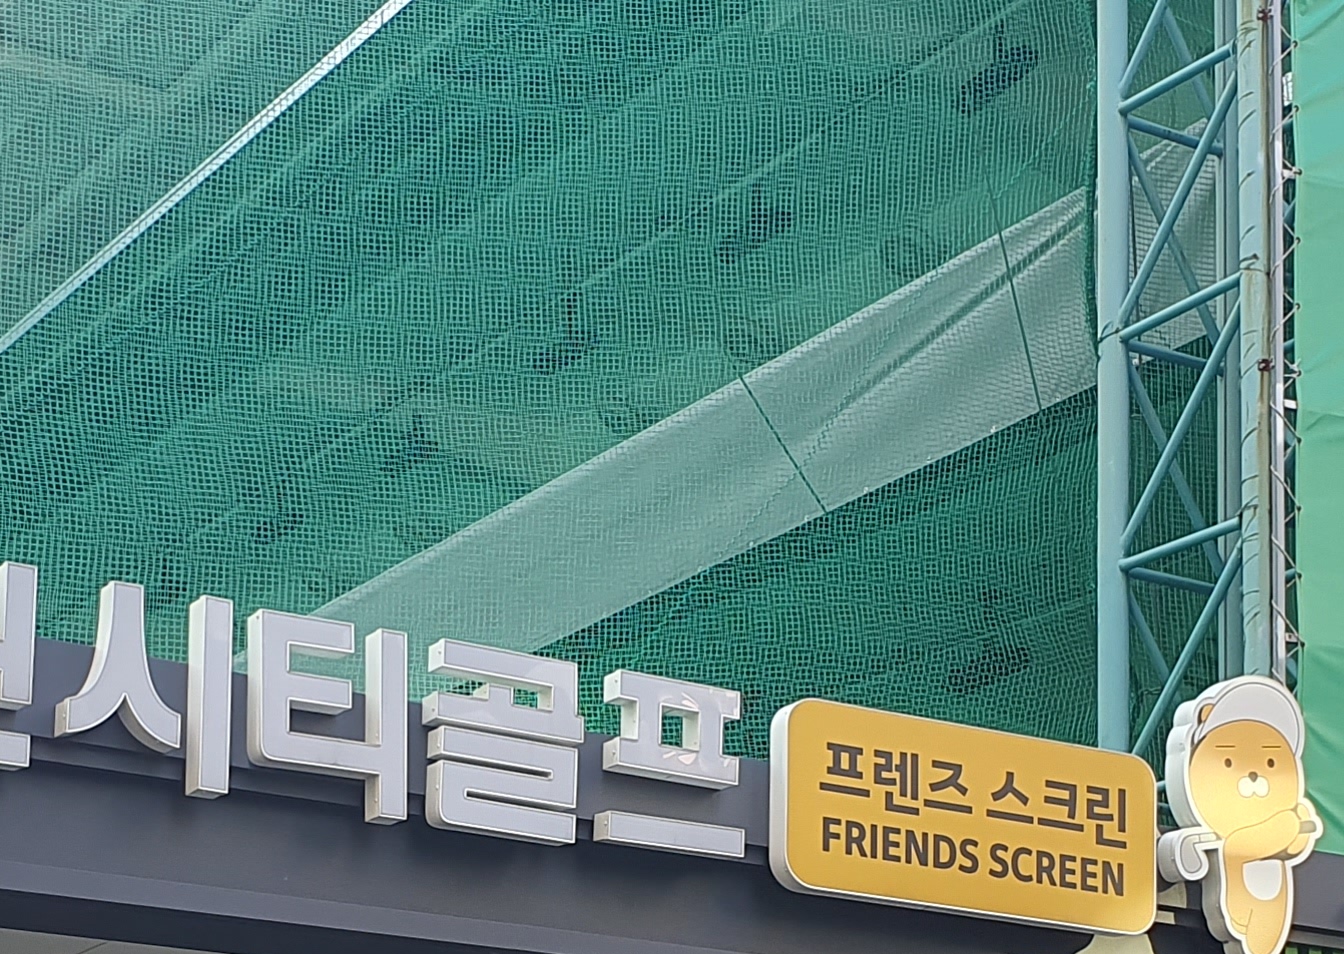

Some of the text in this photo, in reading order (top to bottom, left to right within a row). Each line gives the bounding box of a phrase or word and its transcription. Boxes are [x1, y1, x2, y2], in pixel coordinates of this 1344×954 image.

[818, 741, 1128, 850] 프렌즈 스크린
[821, 815, 1125, 898] FRIENDS SCREEN
